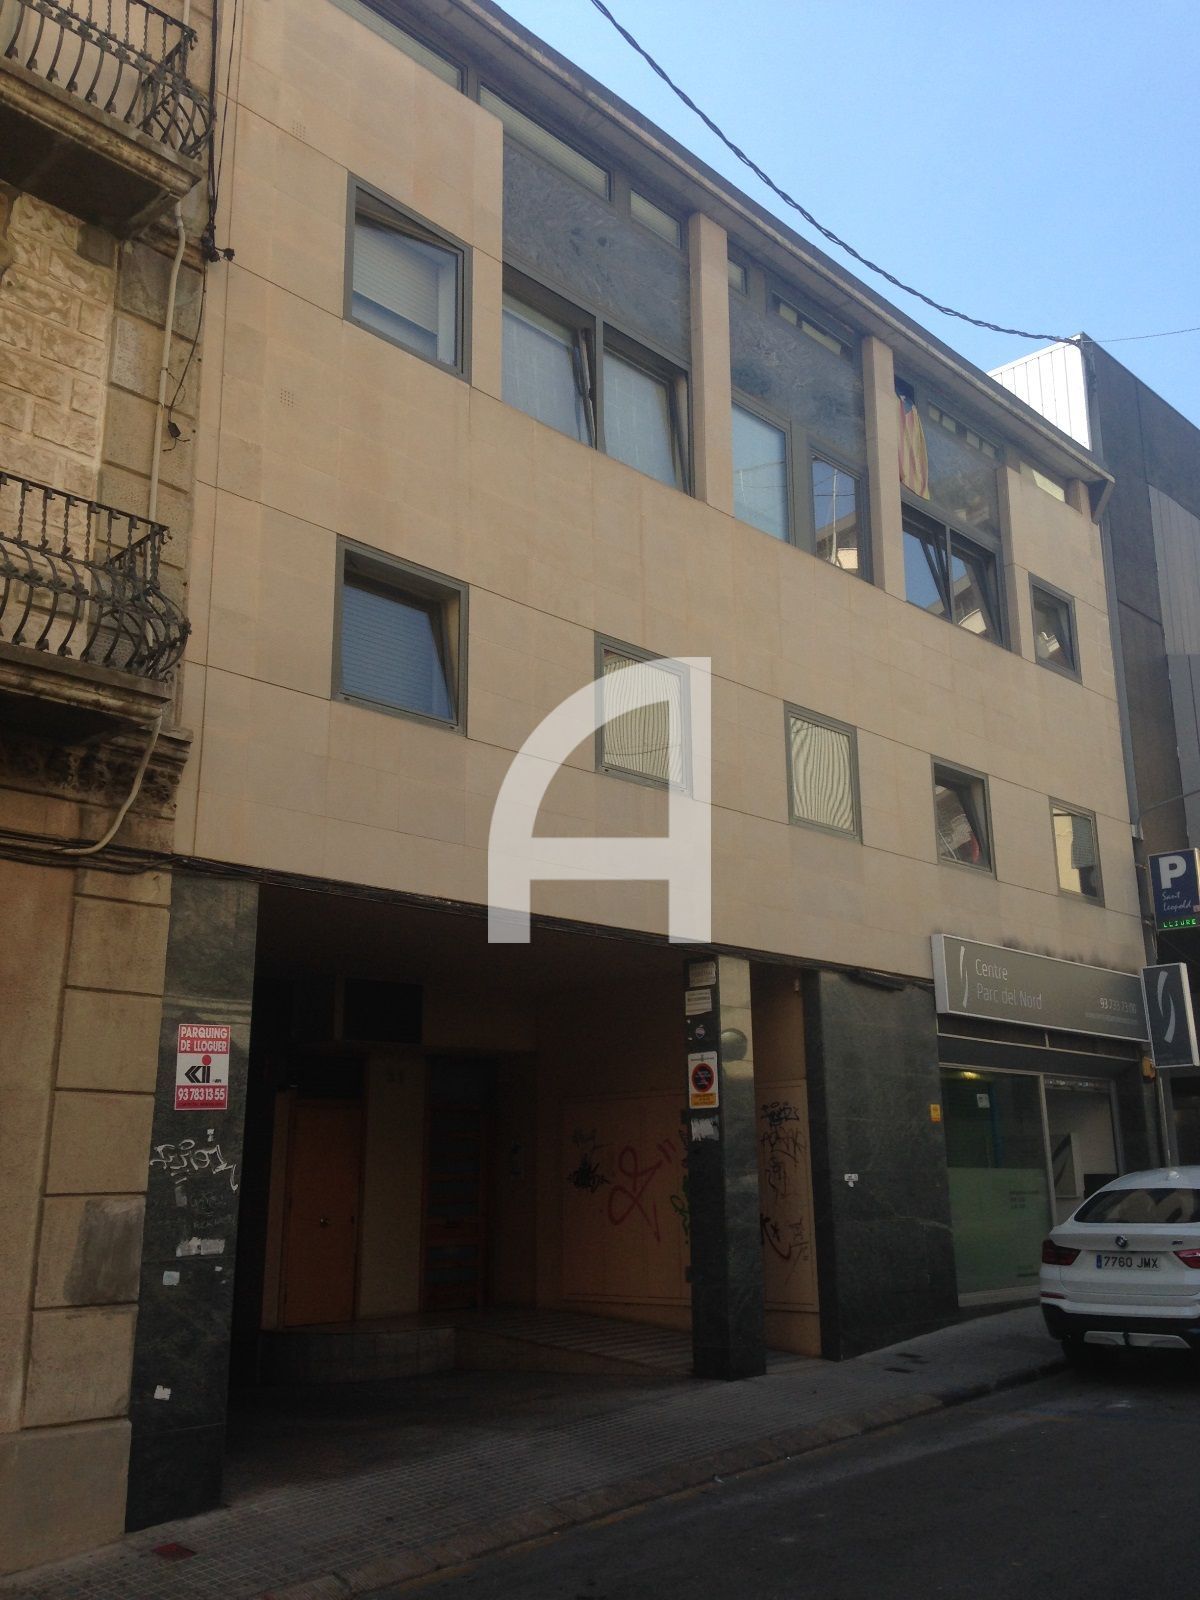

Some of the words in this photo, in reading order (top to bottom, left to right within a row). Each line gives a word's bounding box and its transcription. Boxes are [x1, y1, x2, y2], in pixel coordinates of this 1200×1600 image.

[1158, 855, 1187, 889] P
[975, 958, 1008, 981] Centre
[977, 983, 998, 1001] Parc
[1002, 987, 1016, 1005] del
[1019, 990, 1042, 1010] Nord
[180, 1026, 228, 1039] PARQUING
[181, 1040, 193, 1051] DE
[193, 1041, 227, 1052] LLOGUER
[1104, 1256, 1133, 1268] 7760
[1137, 1257, 1158, 1269] JMX
